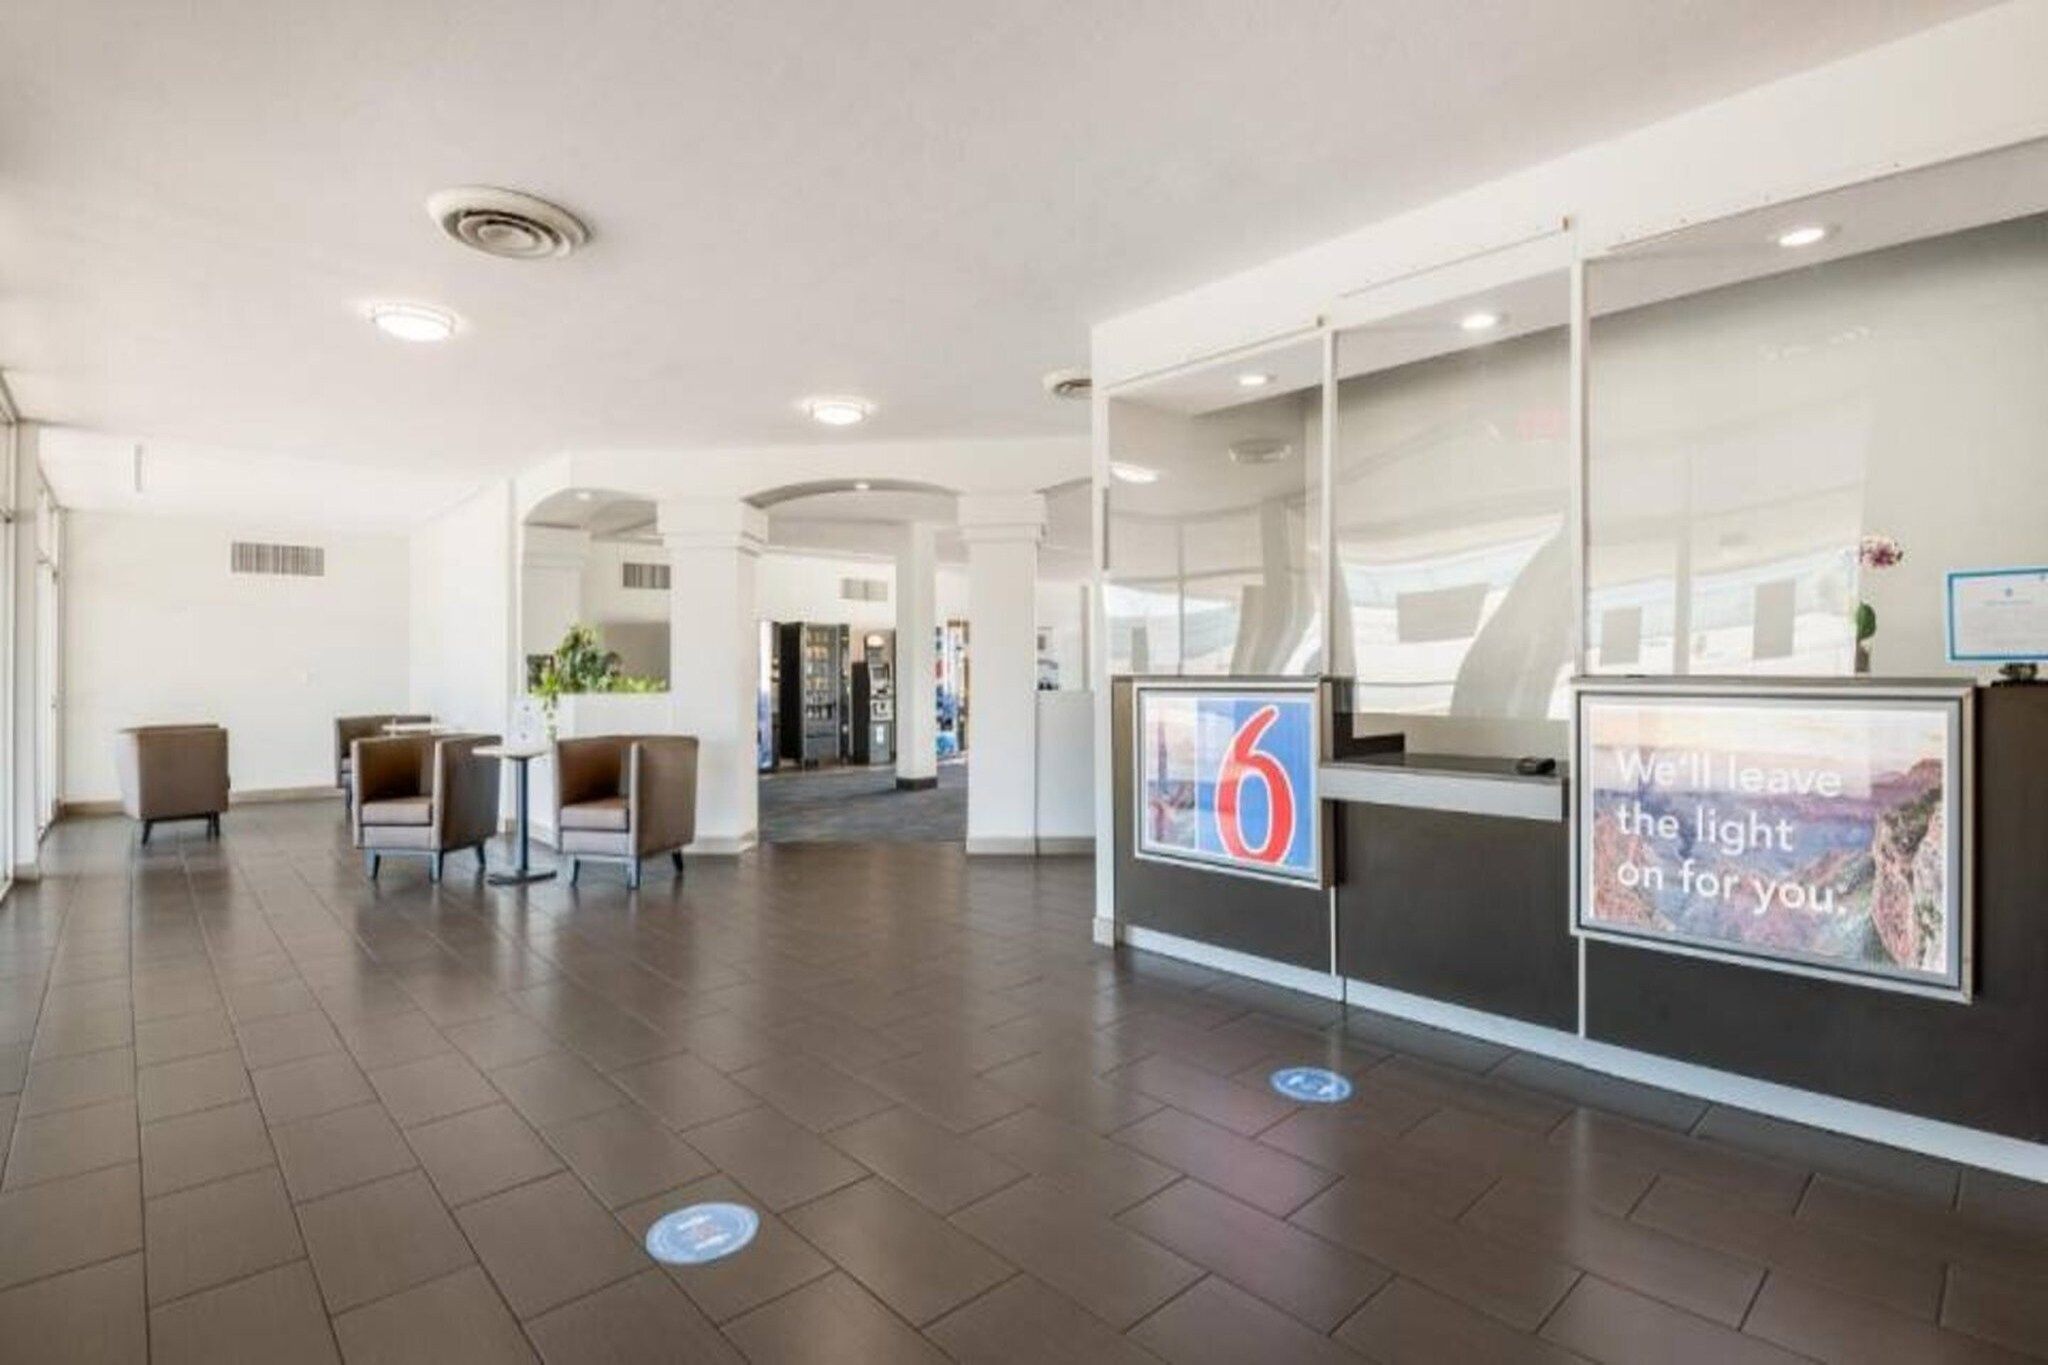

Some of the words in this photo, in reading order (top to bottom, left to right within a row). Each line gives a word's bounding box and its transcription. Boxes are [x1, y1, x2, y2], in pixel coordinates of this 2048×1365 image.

[1215, 704, 1296, 866] 6
[1617, 750, 1711, 788] We'll
[1728, 755, 1842, 797] leave
[1617, 801, 1680, 840] the
[1697, 808, 1793, 857] light
[1617, 860, 1664, 890] on
[1679, 858, 1739, 899] for
